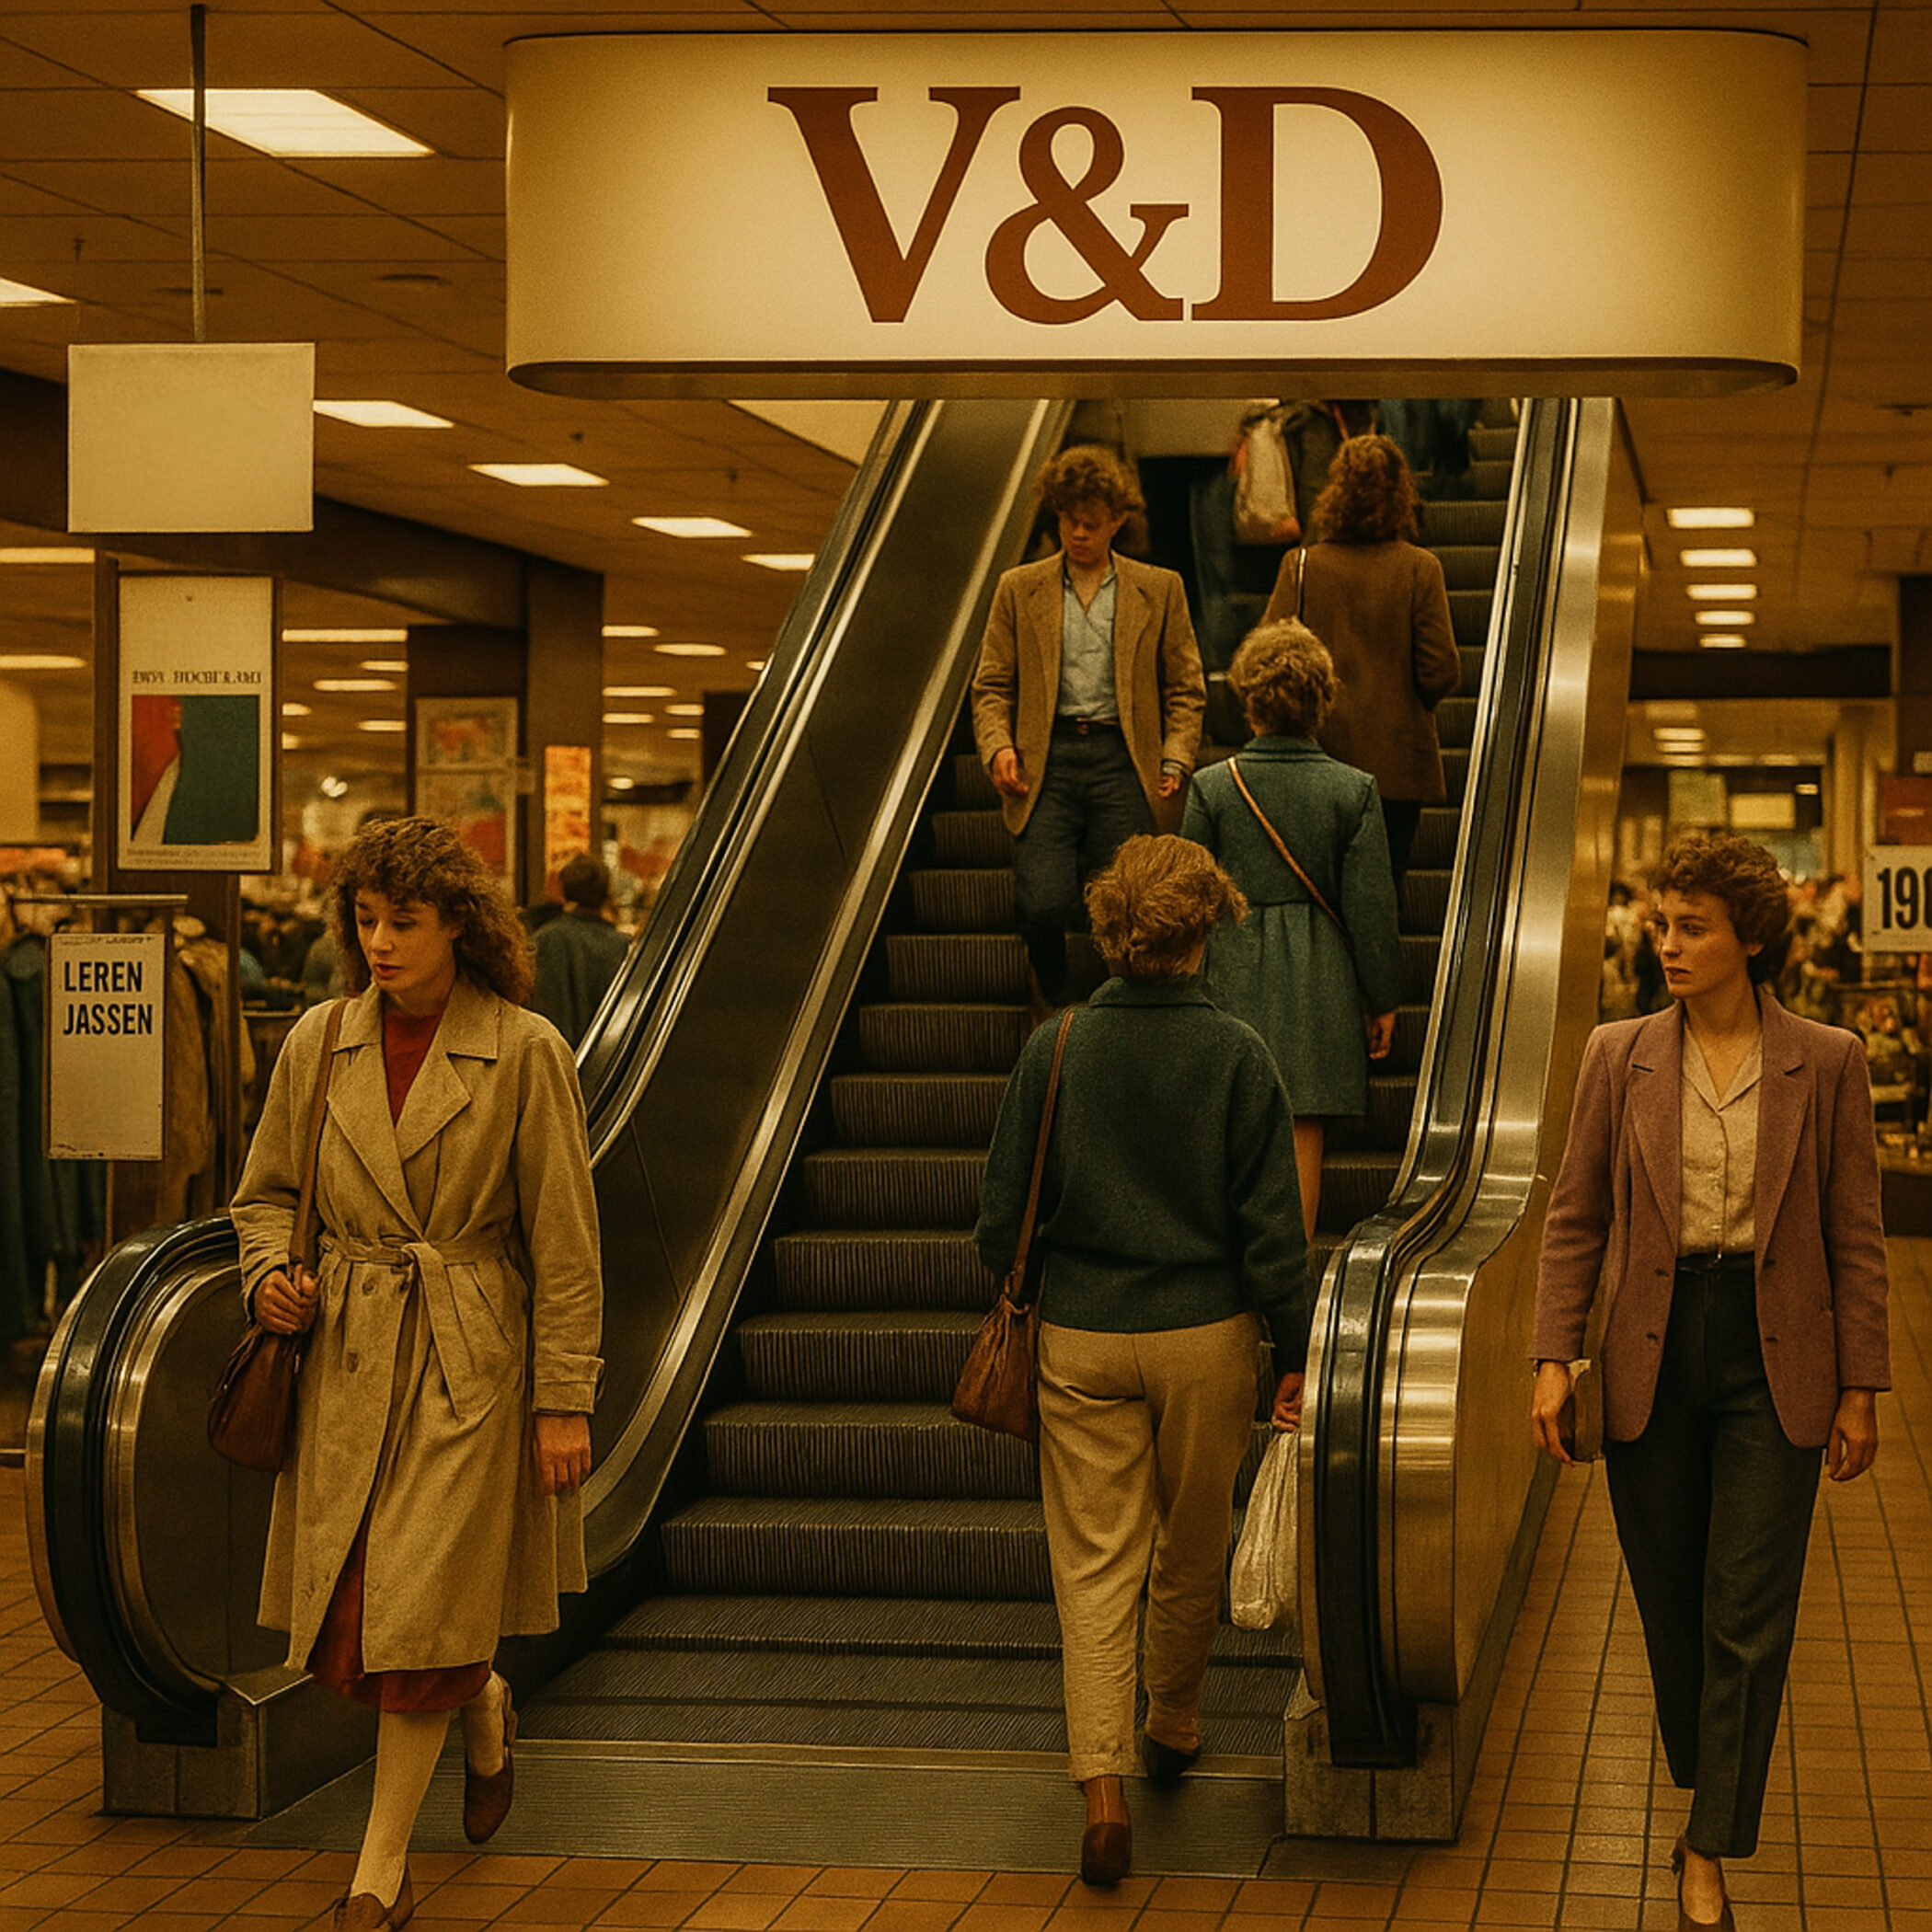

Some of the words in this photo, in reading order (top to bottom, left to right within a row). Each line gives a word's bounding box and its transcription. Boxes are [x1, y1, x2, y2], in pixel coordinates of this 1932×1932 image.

[766, 86, 1443, 326] V&D
[63, 960, 143, 993] LEREN
[63, 1003, 154, 1036] JASSEN
